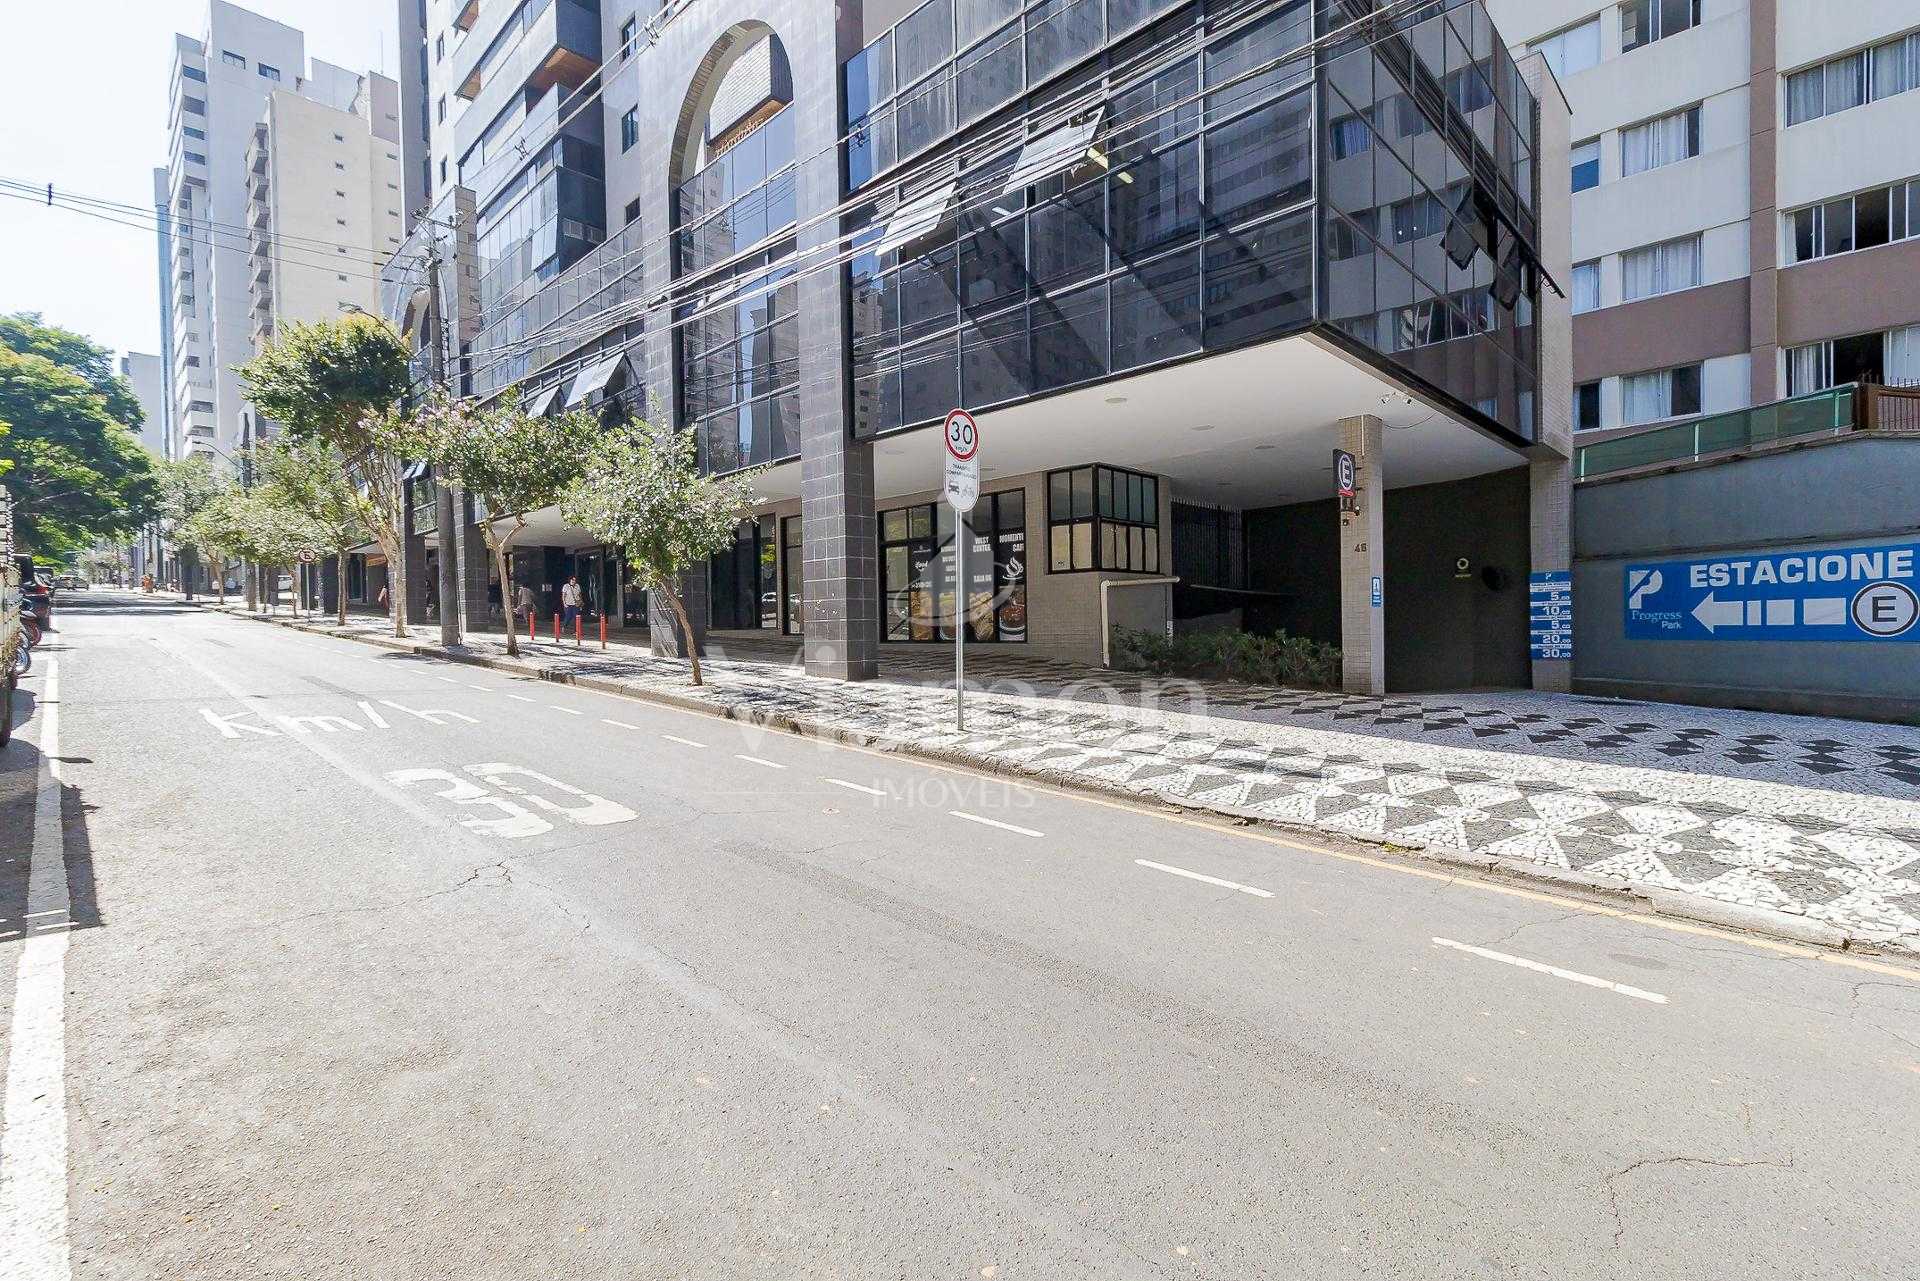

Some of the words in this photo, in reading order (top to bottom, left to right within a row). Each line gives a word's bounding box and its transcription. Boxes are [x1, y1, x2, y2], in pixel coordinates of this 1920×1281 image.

[950, 420, 973, 445] 30
[1690, 550, 1914, 588] ESTACIONE
[1631, 611, 1682, 622] Progress
[1872, 596, 1897, 622] E
[1661, 621, 1682, 630] Park
[384, 762, 640, 838] 30
